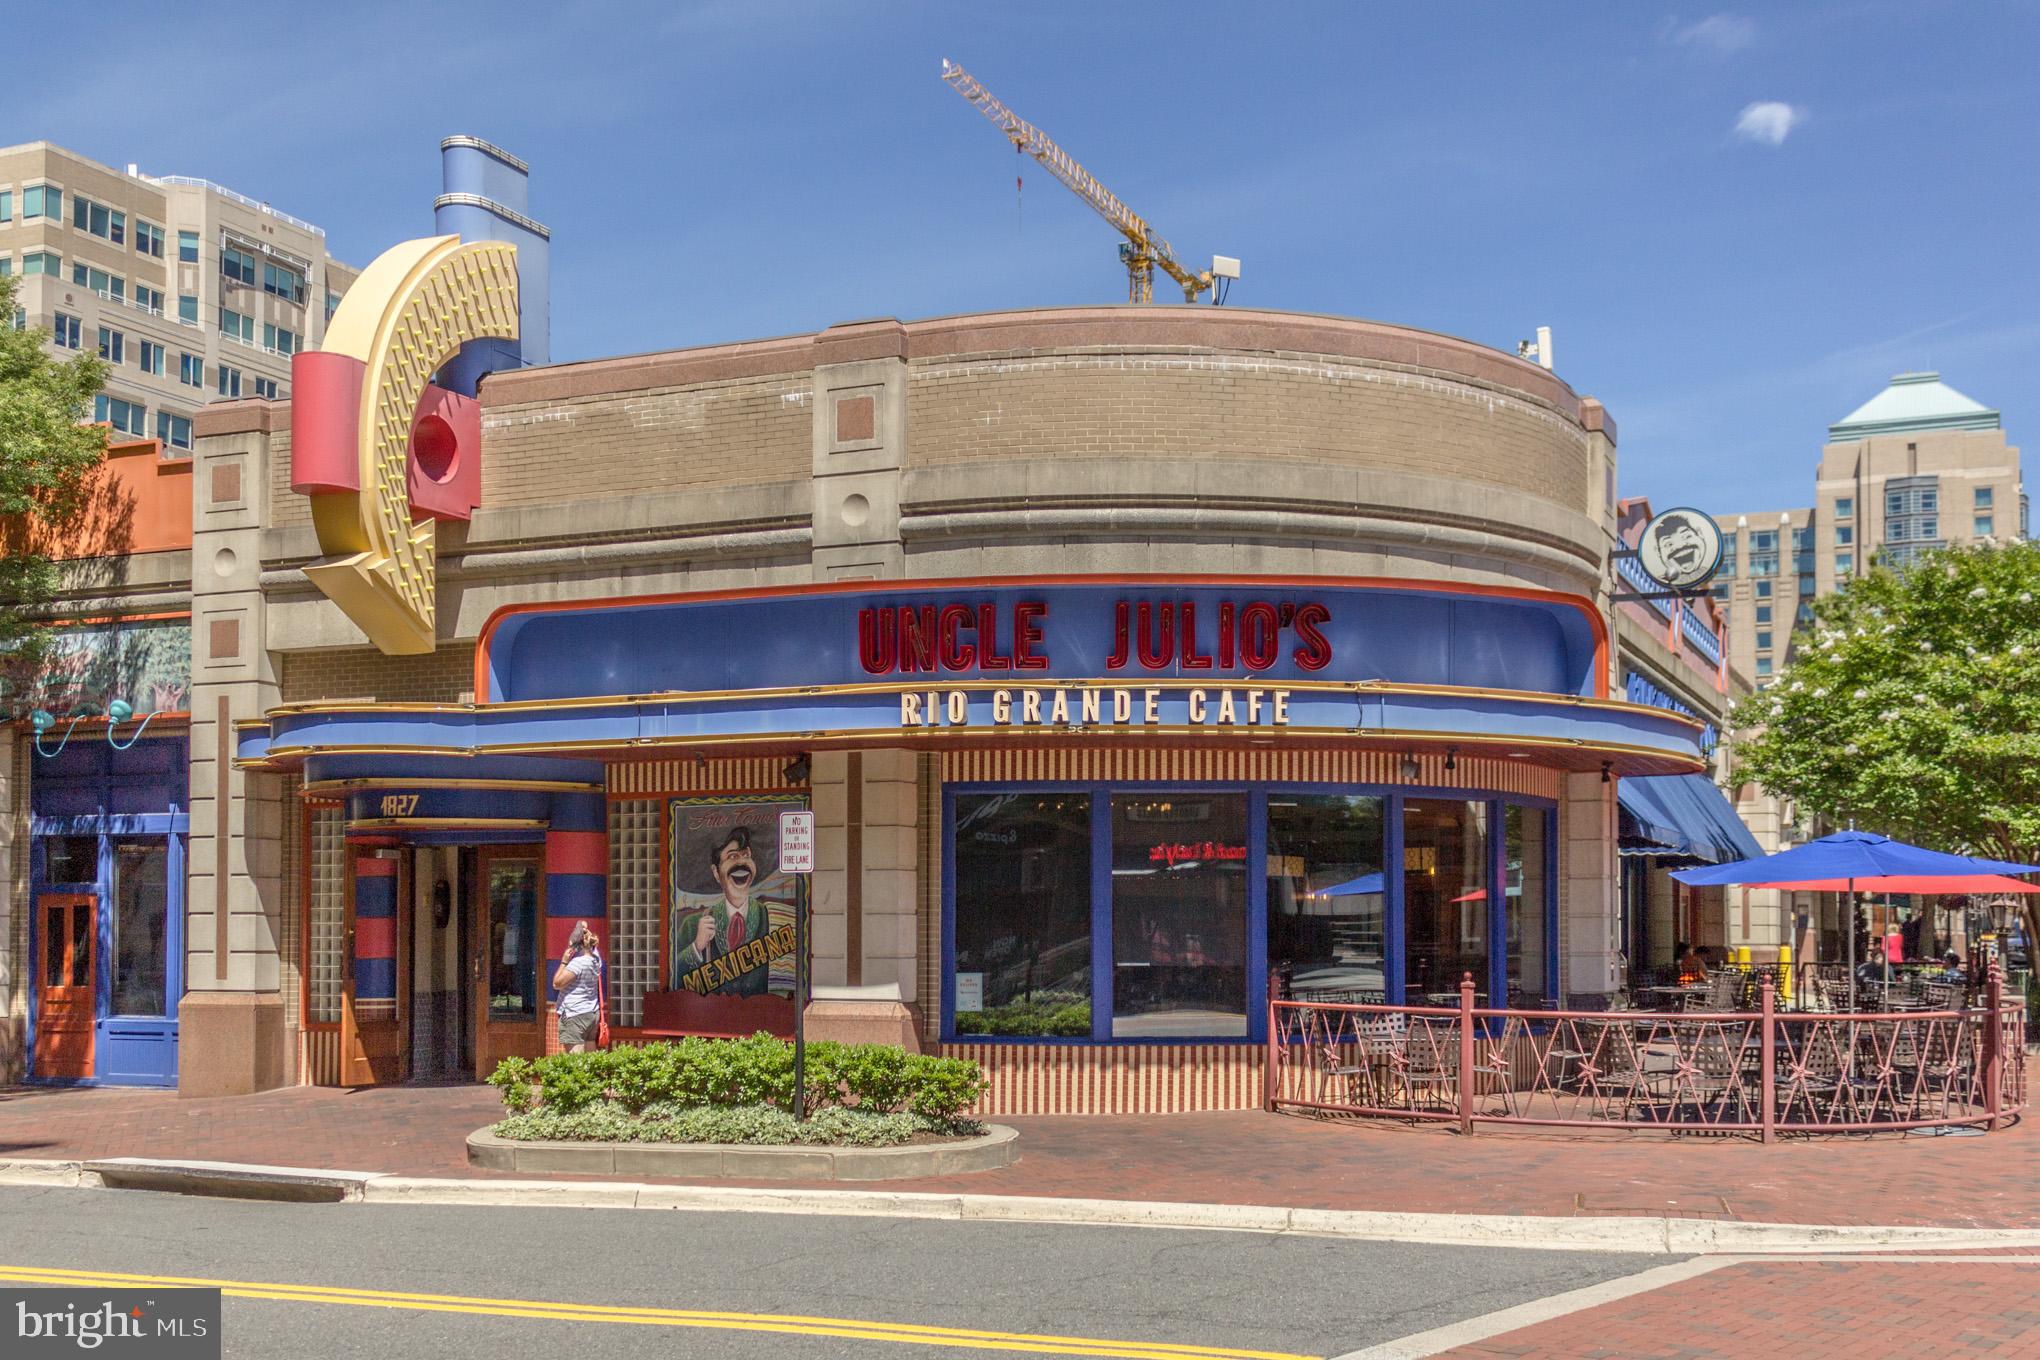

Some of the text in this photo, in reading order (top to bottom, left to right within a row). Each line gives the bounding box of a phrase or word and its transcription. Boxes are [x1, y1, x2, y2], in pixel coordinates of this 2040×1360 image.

[859, 600, 1333, 675] UNCLE JULIO'S
[901, 688, 1291, 726] RIO GRANDE CAFE
[380, 794, 419, 817] 1827
[792, 816, 802, 826] NO
[785, 826, 809, 835] PARKING
[783, 842, 810, 851] STANDING
[783, 855, 809, 865] FIRE LANE
[682, 923, 797, 996] MEXICANA
